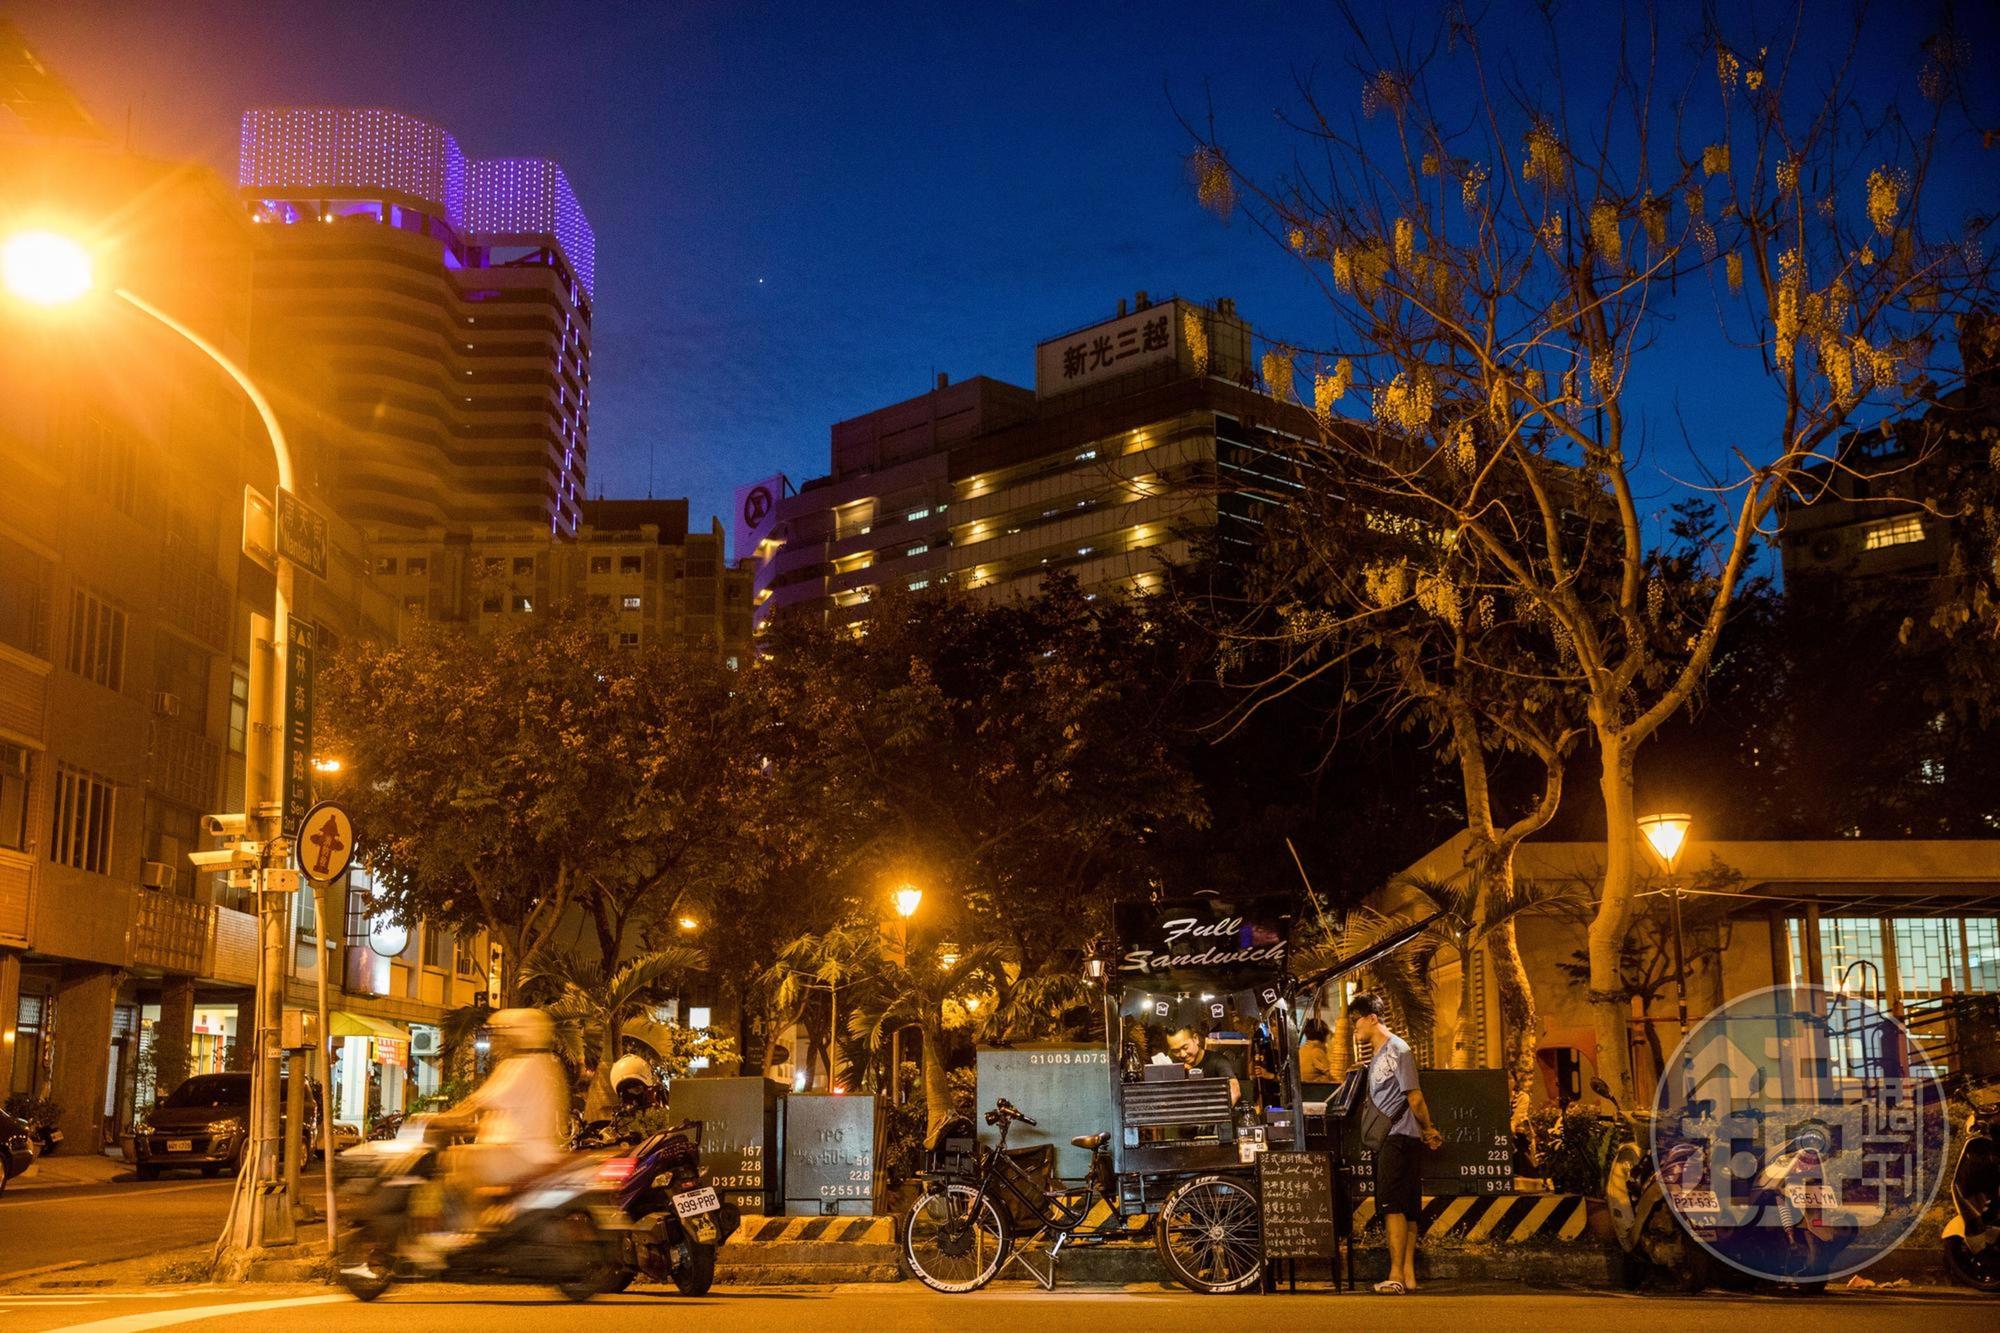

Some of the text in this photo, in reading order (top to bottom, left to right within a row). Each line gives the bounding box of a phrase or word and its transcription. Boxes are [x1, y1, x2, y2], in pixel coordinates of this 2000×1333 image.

[1063, 315, 1169, 379] 新光三越
[293, 650, 306, 781] 林森三路
[291, 783, 304, 799] Lin
[290, 799, 304, 815] Sen
[1162, 916, 1243, 944] Full
[1118, 940, 1287, 972] Sandwich
[1030, 1054, 1071, 1064] Q1003
[1494, 1135, 1508, 1146] 25
[742, 1146, 762, 1157] 167
[856, 1156, 870, 1166] 50
[1460, 1165, 1511, 1176] D98019
[712, 1175, 761, 1187] D32759
[820, 1185, 870, 1196] C25514
